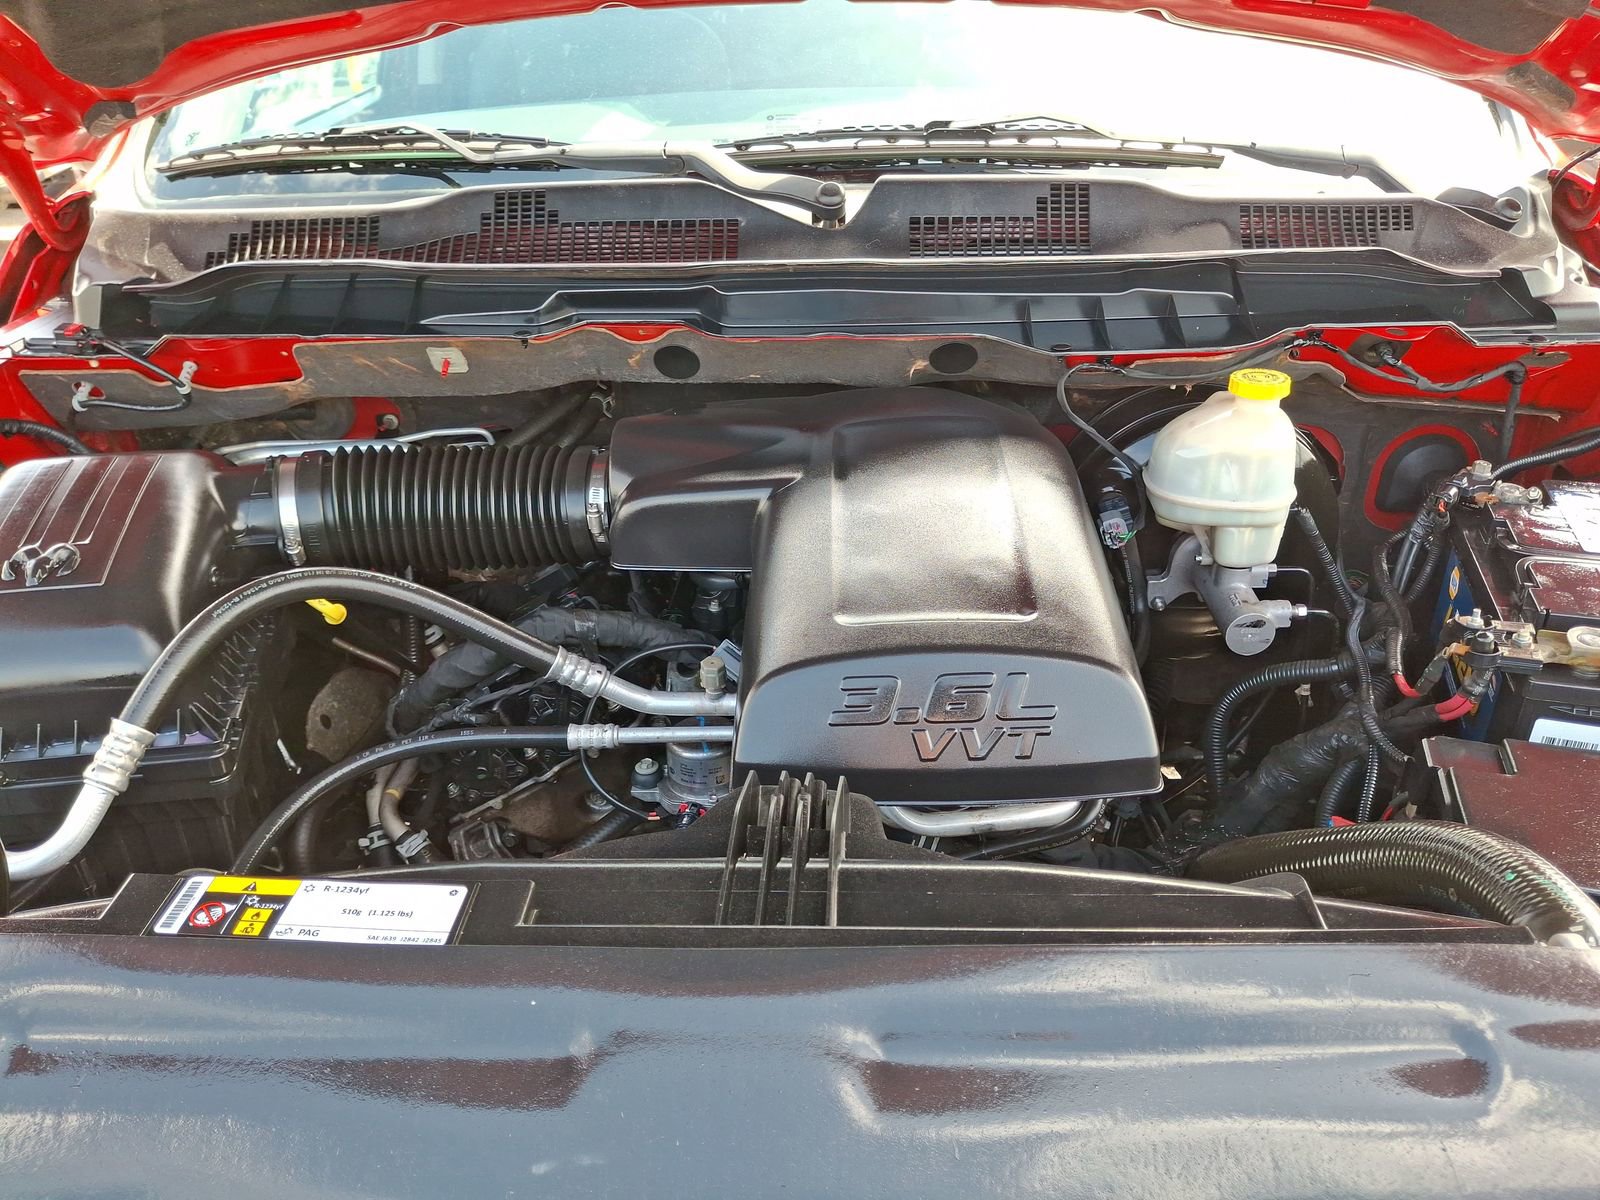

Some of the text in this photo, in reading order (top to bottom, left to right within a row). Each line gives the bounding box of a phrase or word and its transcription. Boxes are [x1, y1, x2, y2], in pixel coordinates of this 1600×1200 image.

[828, 671, 1058, 726] 3.6L
[911, 725, 1052, 761] VVT
[324, 885, 370, 895] R-1234yf
[368, 909, 395, 917] (1.125
[397, 910, 414, 918] lbs)
[298, 929, 320, 937] PAG
